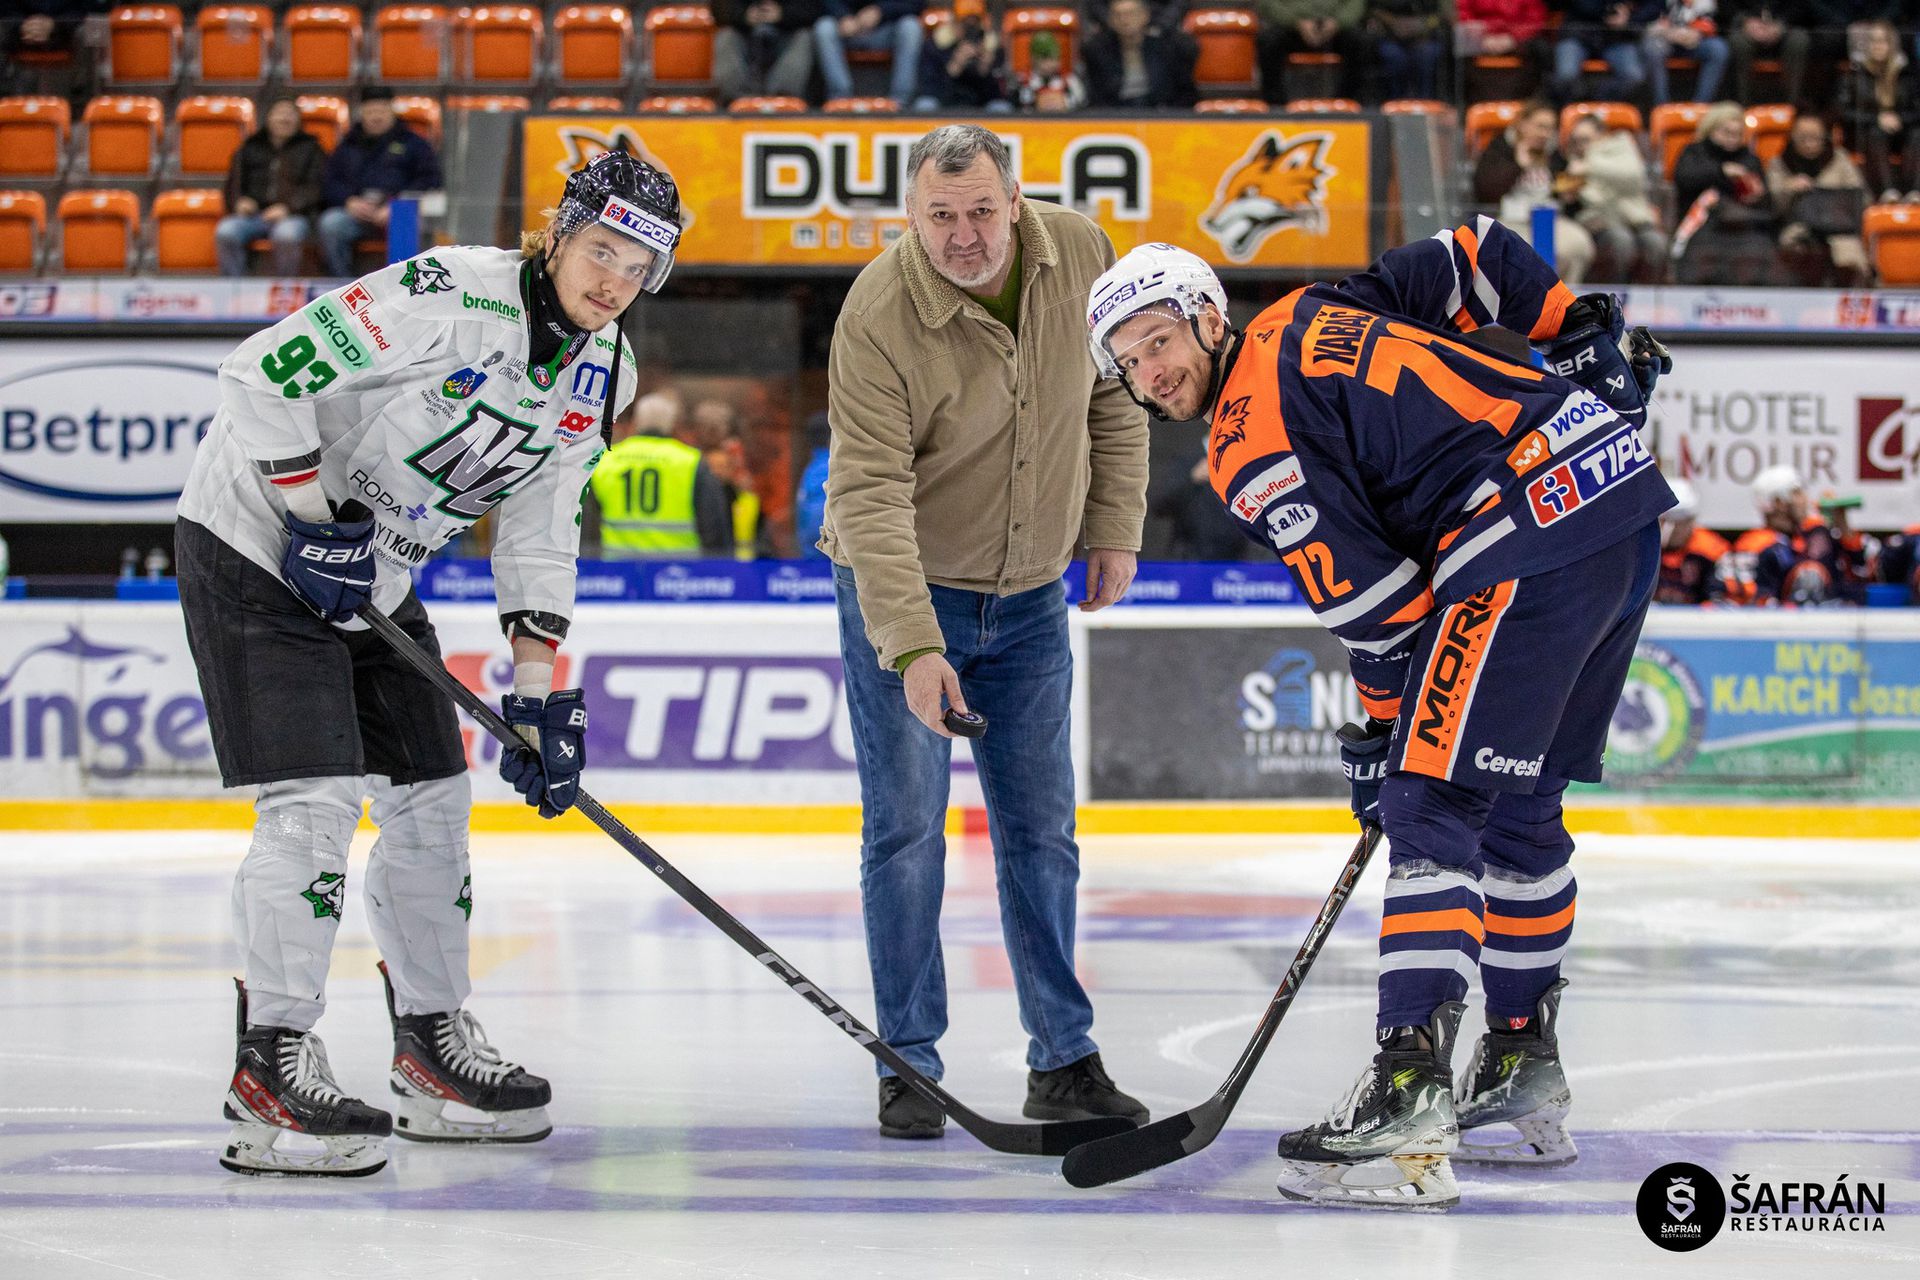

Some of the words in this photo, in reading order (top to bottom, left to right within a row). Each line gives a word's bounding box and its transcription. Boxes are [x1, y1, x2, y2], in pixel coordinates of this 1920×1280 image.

[626, 212, 674, 246] TIPOS
[462, 291, 521, 320] brantner
[1094, 283, 1133, 320] TIPOS
[260, 334, 339, 400] 93
[1690, 393, 1838, 435] HOTEL
[350, 469, 402, 518] ROPA
[621, 467, 659, 515] 10
[1282, 541, 1354, 605] 72
[604, 665, 864, 762] TIP
[1711, 675, 1841, 716] KARCH
[756, 951, 878, 1046] CCM
[238, 1073, 293, 1128] CCM
[401, 1058, 445, 1096] CCM
